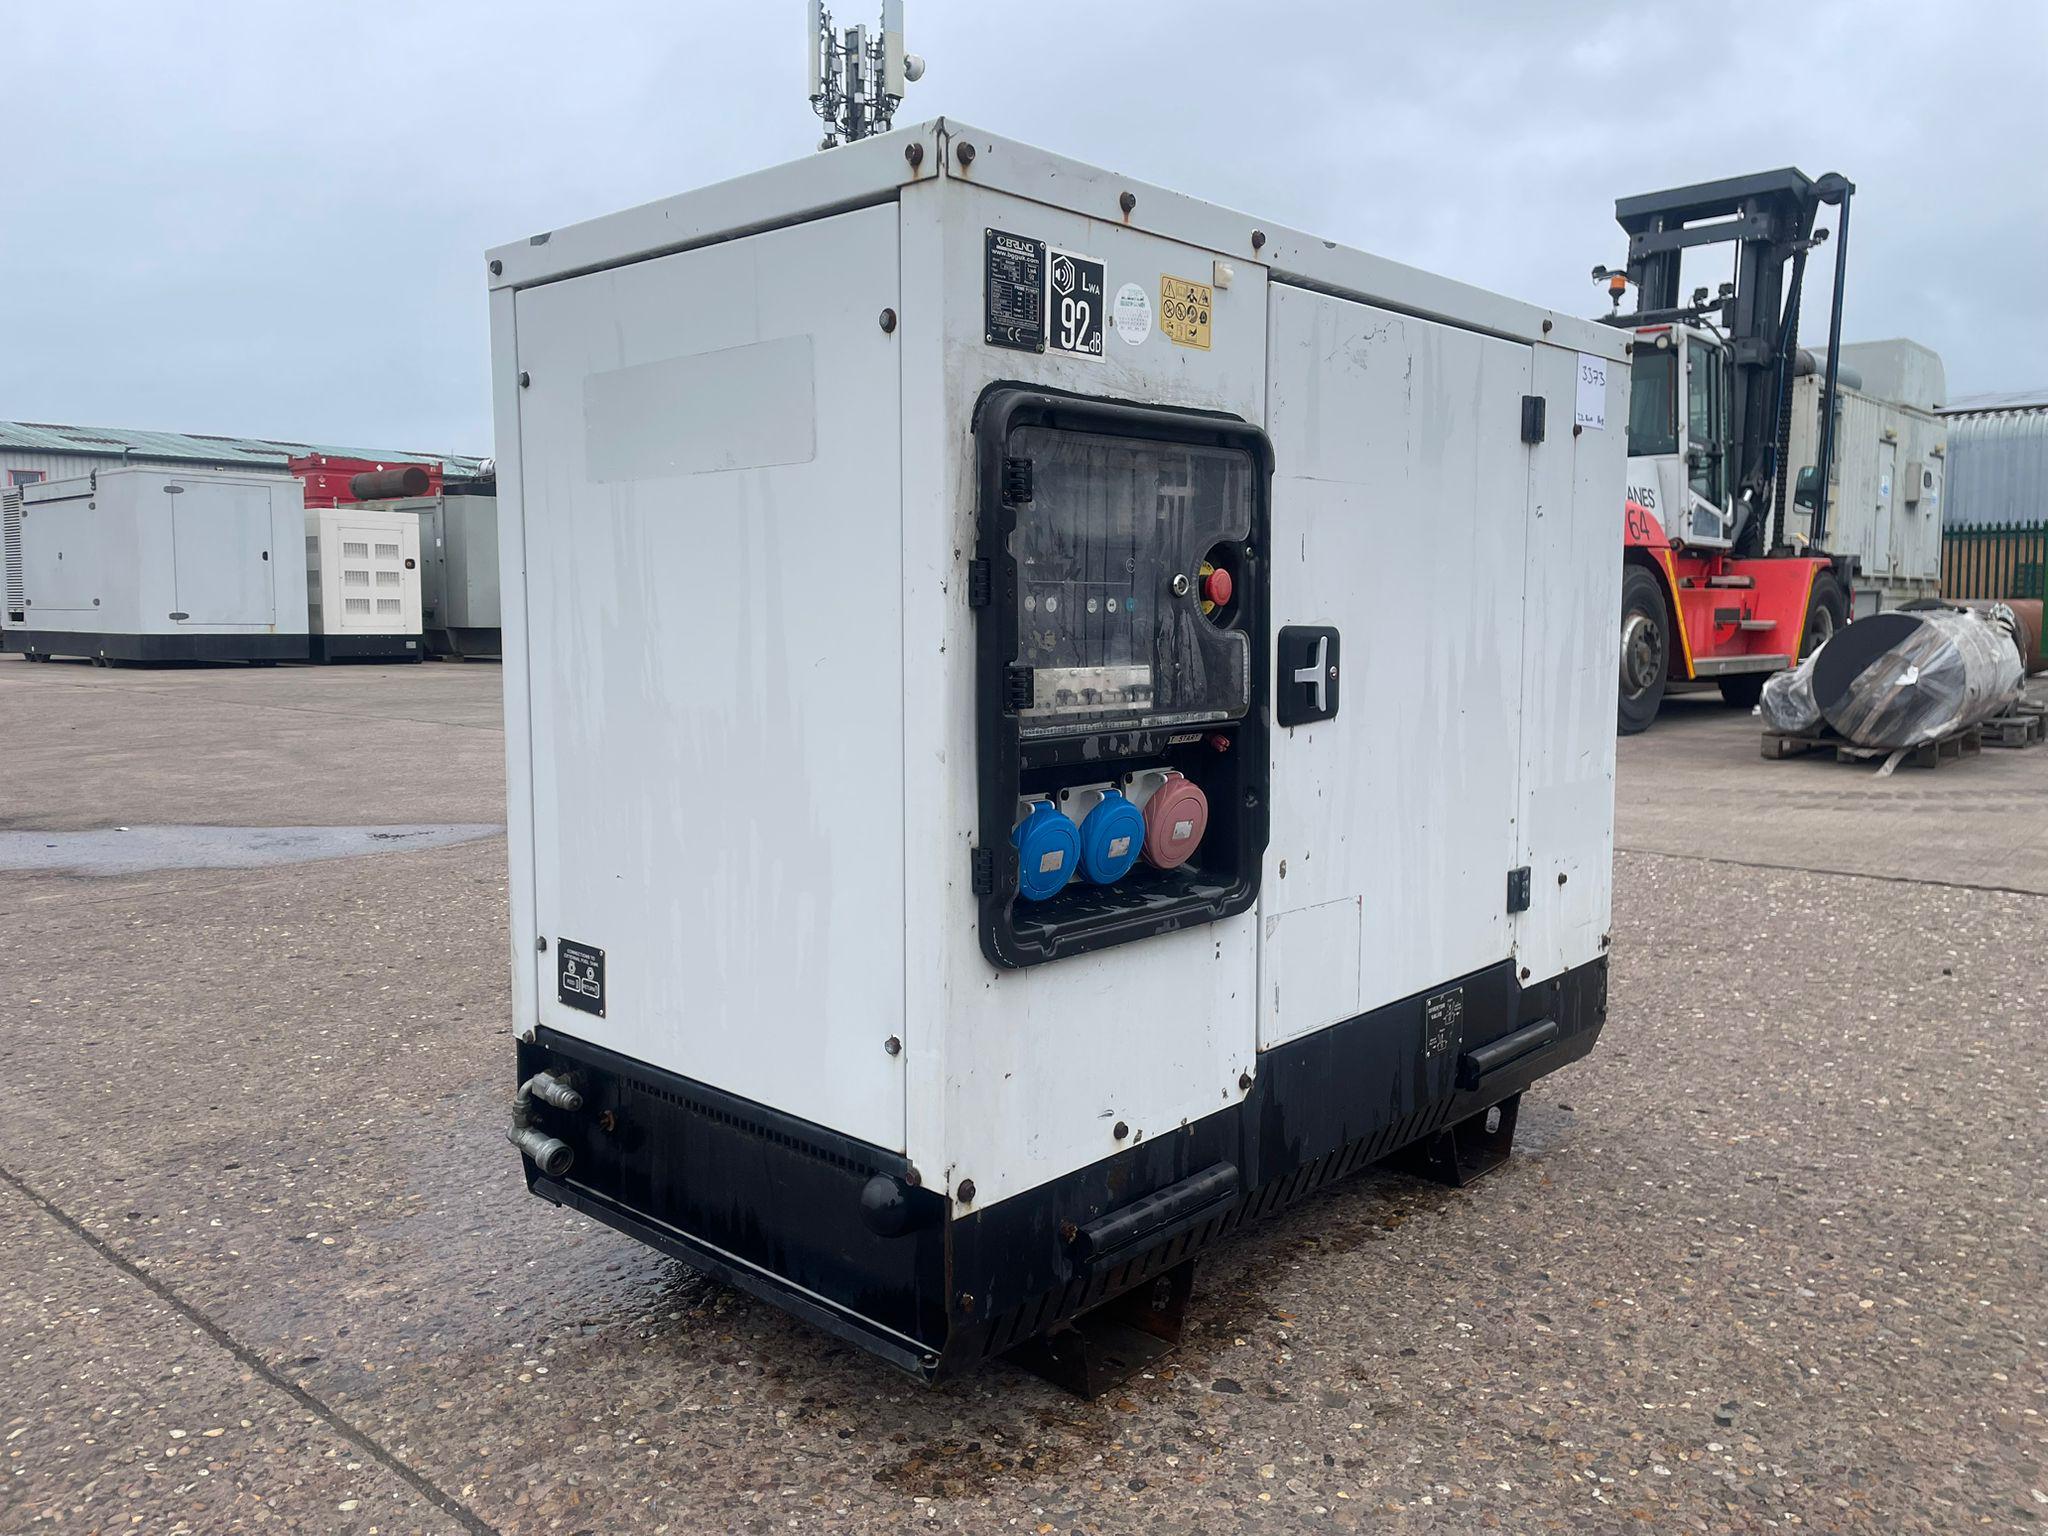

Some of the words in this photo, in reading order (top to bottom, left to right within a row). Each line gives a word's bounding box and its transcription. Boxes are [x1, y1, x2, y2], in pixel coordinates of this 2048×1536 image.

[1061, 297, 1090, 352] 92
[1089, 331, 1101, 353] dB
[1627, 485, 1655, 509] ANES
[1628, 510, 1650, 540] 64
